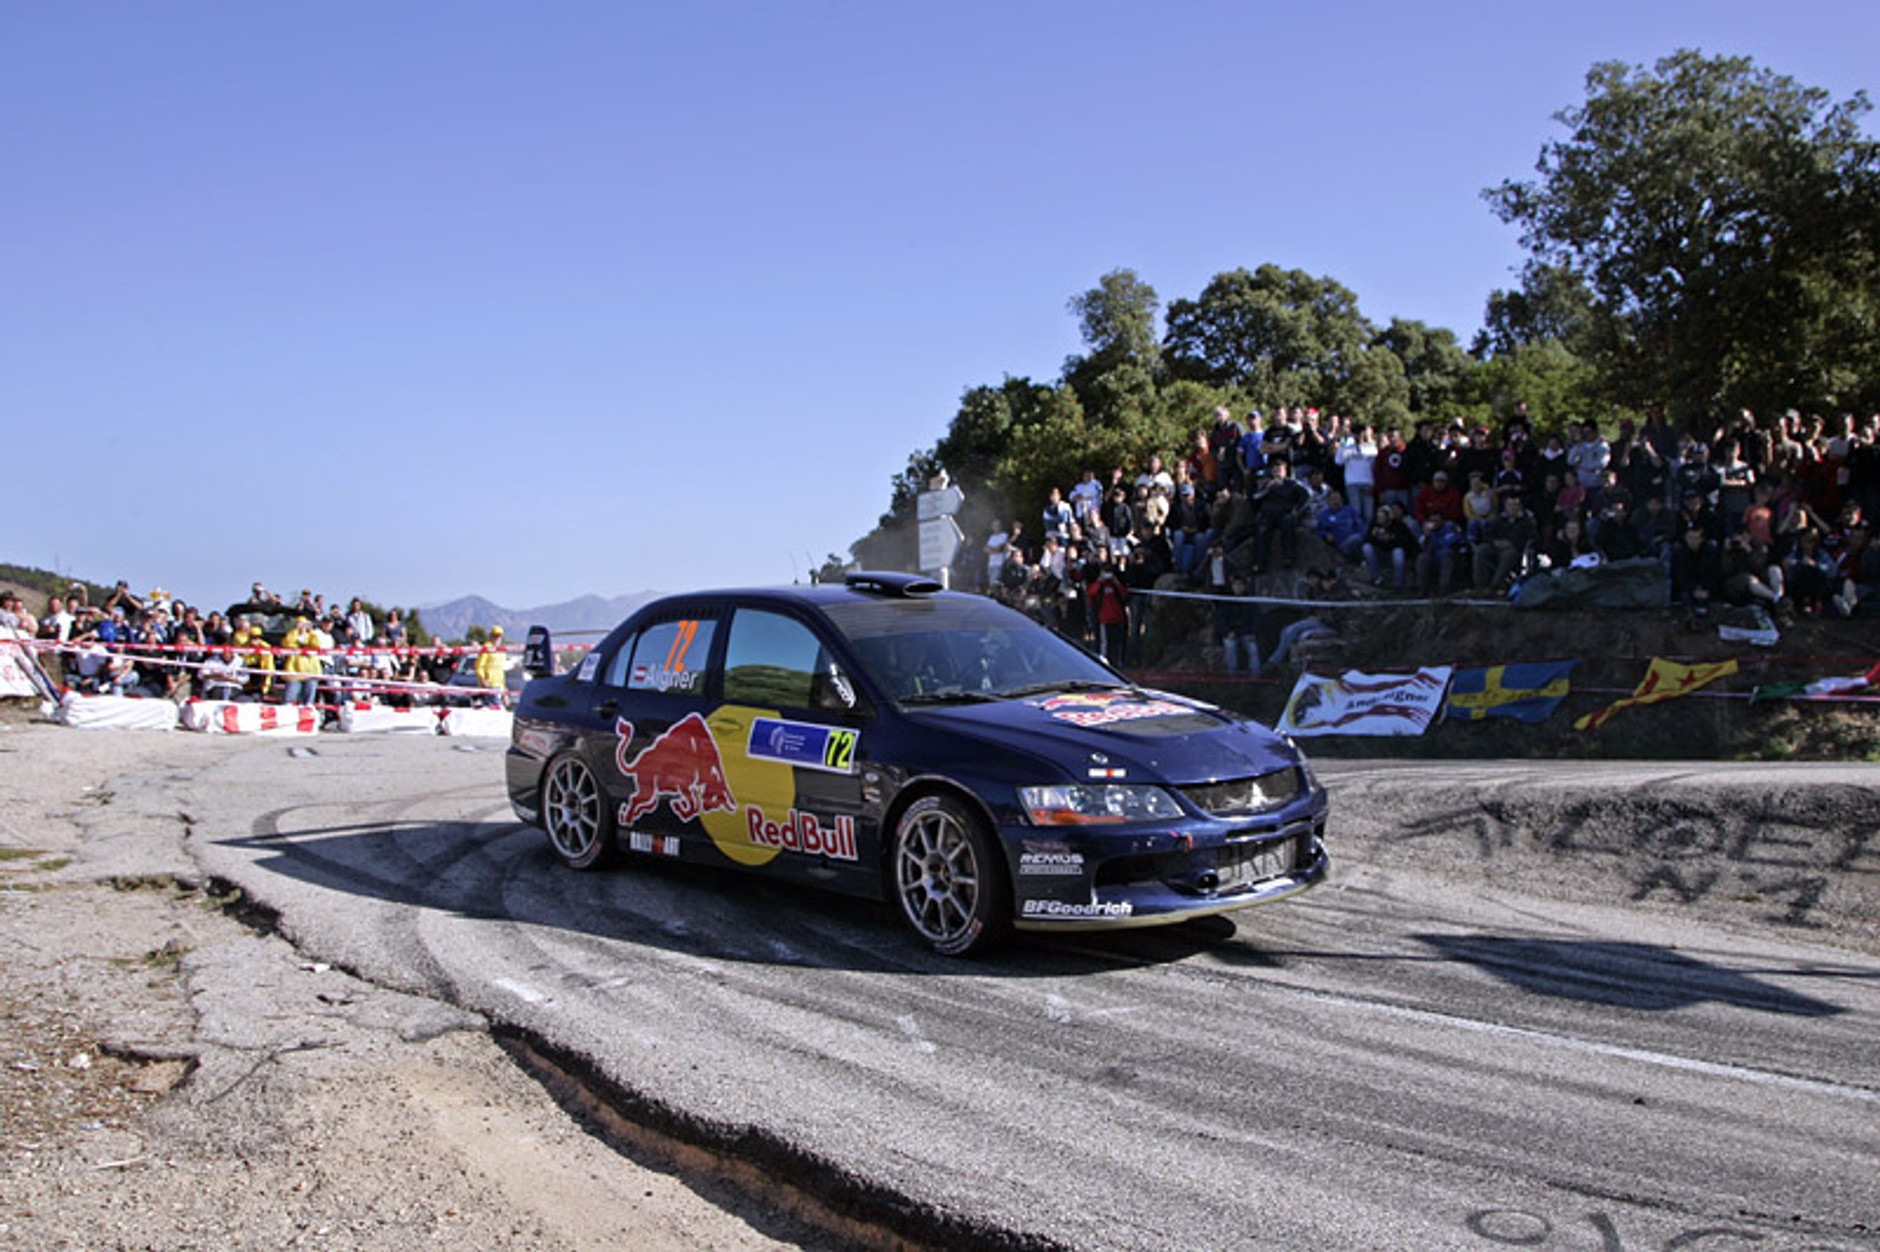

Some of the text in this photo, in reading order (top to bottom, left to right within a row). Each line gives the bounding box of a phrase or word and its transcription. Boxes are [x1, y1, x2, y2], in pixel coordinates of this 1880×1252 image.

[663, 620, 698, 672] 72
[825, 730, 855, 768] 72
[747, 805, 802, 851] Red
[799, 812, 859, 861] Bull
[1023, 899, 1133, 917] BFGoodrich
